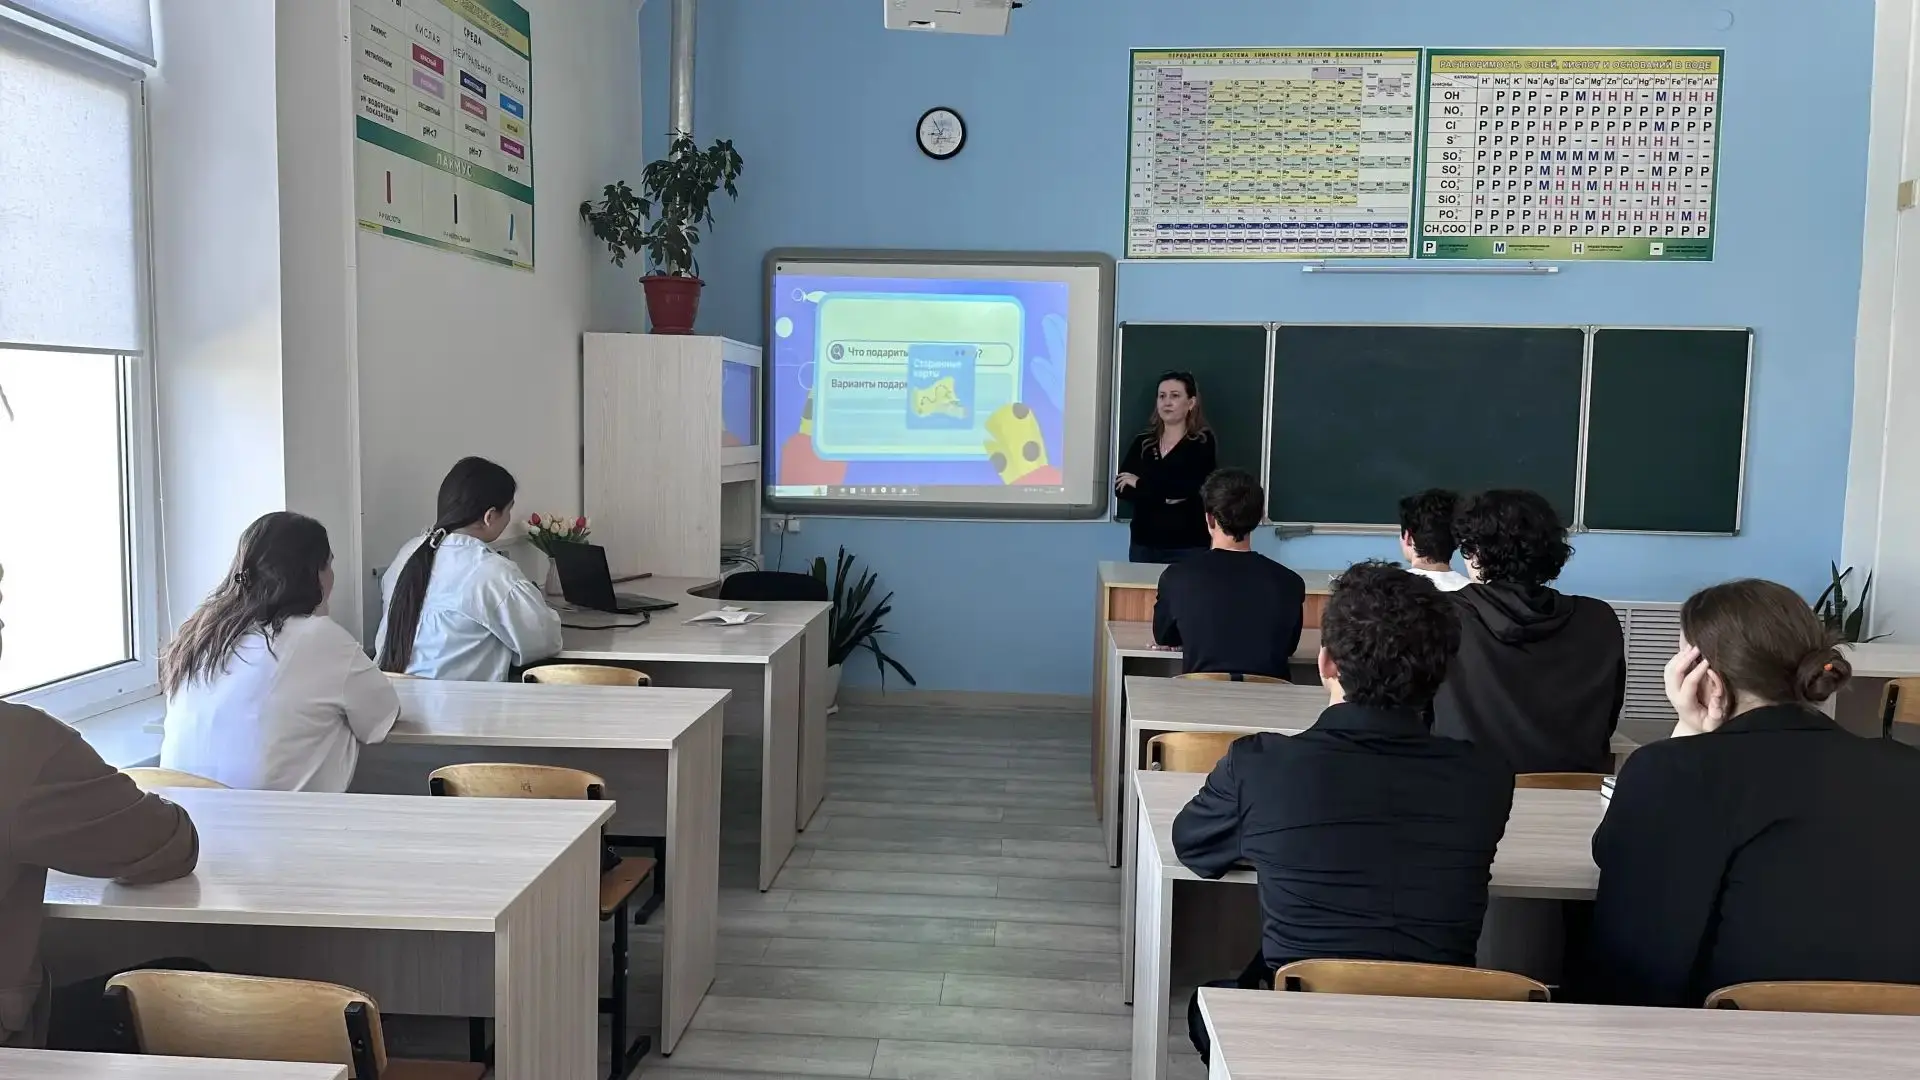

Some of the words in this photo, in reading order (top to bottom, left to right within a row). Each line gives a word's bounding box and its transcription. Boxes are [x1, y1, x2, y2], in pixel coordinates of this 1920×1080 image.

[415, 24, 440, 44] КИСЛАЯ
[464, 27, 482, 46] СРЕДА
[452, 46, 492, 76] НЕЙТРАЛЬНАЯ
[1440, 60, 1522, 69] РАСТВОРИМОСТЬ
[1562, 60, 1600, 69] КИСЛОТ
[1602, 60, 1611, 69] И
[1613, 60, 1672, 70] ОСНОВАНИЙ
[1676, 61, 1682, 69] В
[1686, 61, 1712, 70] ВОДЕ
[1480, 106, 1488, 115] Р
[1496, 106, 1504, 115] Р
[1512, 106, 1520, 115] Р
[1528, 106, 1536, 115] Р
[1544, 106, 1552, 115] Р
[1560, 106, 1568, 115] Р
[1576, 106, 1584, 116] Р
[1592, 106, 1600, 115] Р
[1608, 106, 1616, 116] Р
[1624, 106, 1632, 116] Р
[1640, 106, 1648, 116] Р
[1656, 106, 1664, 116] Р
[1672, 106, 1680, 116] Р
[1688, 106, 1696, 116] Р
[1704, 106, 1712, 116] Р
[1480, 120, 1487, 130] Р
[1496, 120, 1503, 130] Р
[1512, 120, 1519, 130] Р
[1526, 120, 1535, 130] Р
[1542, 120, 1551, 130] Н
[1558, 120, 1567, 130] Р
[1574, 120, 1583, 130] Р
[1590, 120, 1599, 130] Р
[1606, 120, 1615, 130] Р
[1622, 122, 1631, 131] Р
[1638, 122, 1647, 131] Р
[1654, 122, 1664, 131] М
[1670, 122, 1679, 131] Р
[1688, 122, 1695, 131] Р
[1704, 122, 1711, 131] Р
[436, 152, 473, 178] ЛАКМУС
[1474, 210, 1483, 219] Р
[1490, 210, 1499, 219] Р
[1506, 210, 1515, 219] Р
[1522, 210, 1531, 219] Р
[1538, 210, 1547, 219] Н
[1554, 210, 1562, 220] Н
[1570, 210, 1578, 220] Н
[1586, 210, 1595, 220] М
[1602, 210, 1610, 220] Н
[1618, 210, 1626, 220] Н
[1634, 210, 1642, 220] Н
[1650, 210, 1658, 220] Н
[1666, 212, 1674, 220] Н
[1682, 210, 1691, 220] М
[1698, 212, 1706, 221] Н
[1474, 224, 1482, 234] Р
[1490, 224, 1498, 234] Р
[1506, 224, 1514, 234] Р
[1522, 224, 1530, 234] Р
[1538, 224, 1546, 234] Р
[1554, 224, 1561, 234] Р
[1570, 224, 1577, 234] Р
[1586, 226, 1593, 235] Р
[1602, 226, 1609, 235] Р
[1618, 226, 1625, 235] Р
[1634, 226, 1641, 235] Р
[1650, 226, 1657, 235] Р
[1664, 226, 1673, 235] Р
[1682, 226, 1689, 235] Р
[1698, 226, 1705, 236] Р
[1426, 243, 1434, 252] Р
[1495, 243, 1505, 252] М
[1574, 244, 1582, 252] Н
[848, 346, 864, 357] Что
[867, 349, 908, 359] подарить
[832, 378, 876, 390] Варианты
[878, 381, 908, 390] подар
